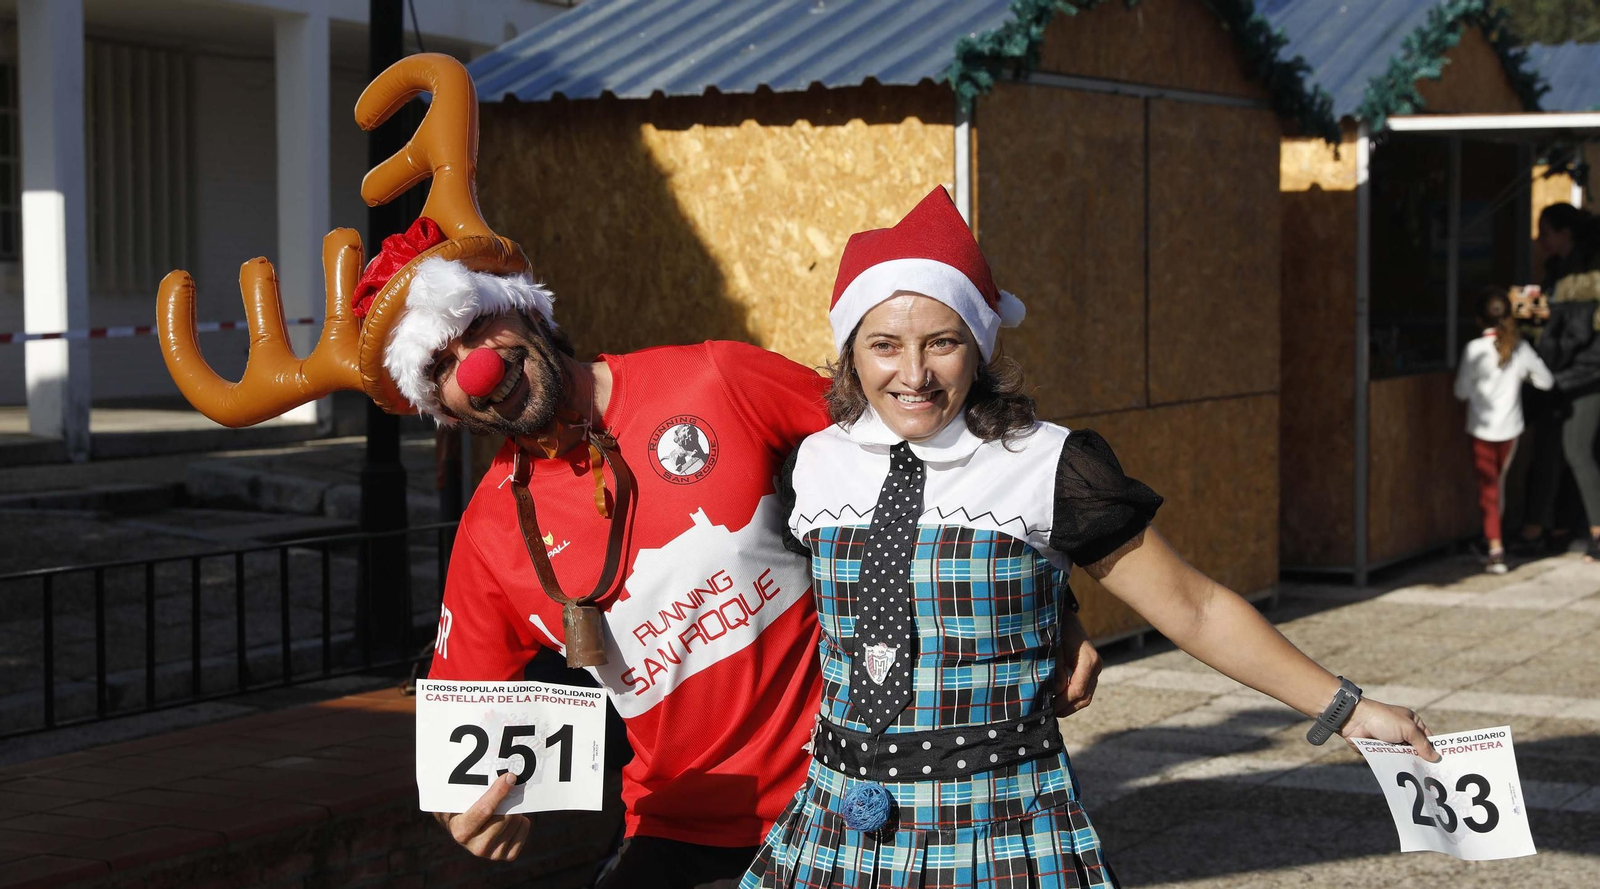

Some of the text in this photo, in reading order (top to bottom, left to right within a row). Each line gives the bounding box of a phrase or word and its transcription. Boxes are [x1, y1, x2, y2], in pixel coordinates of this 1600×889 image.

[650, 417, 697, 451] RUNNING
[663, 440, 716, 482] SAN ROQUE
[632, 569, 734, 647] RUNNING
[620, 568, 781, 696] SAN ROQUE
[425, 693, 597, 708] CASTELLAR DE LA FRONTERA
[426, 684, 458, 692] CROSS
[460, 685, 505, 693] POPULAR
[507, 685, 542, 693] LÚDICO
[551, 688, 602, 699] SOLIDARIO
[448, 724, 574, 786] 251
[1365, 746, 1413, 755] CASTELLAR
[1441, 740, 1504, 756] FRONTERA
[1448, 737, 1455, 745] Y
[1456, 731, 1506, 744] SOLIDARIO
[1396, 771, 1500, 834] 233
